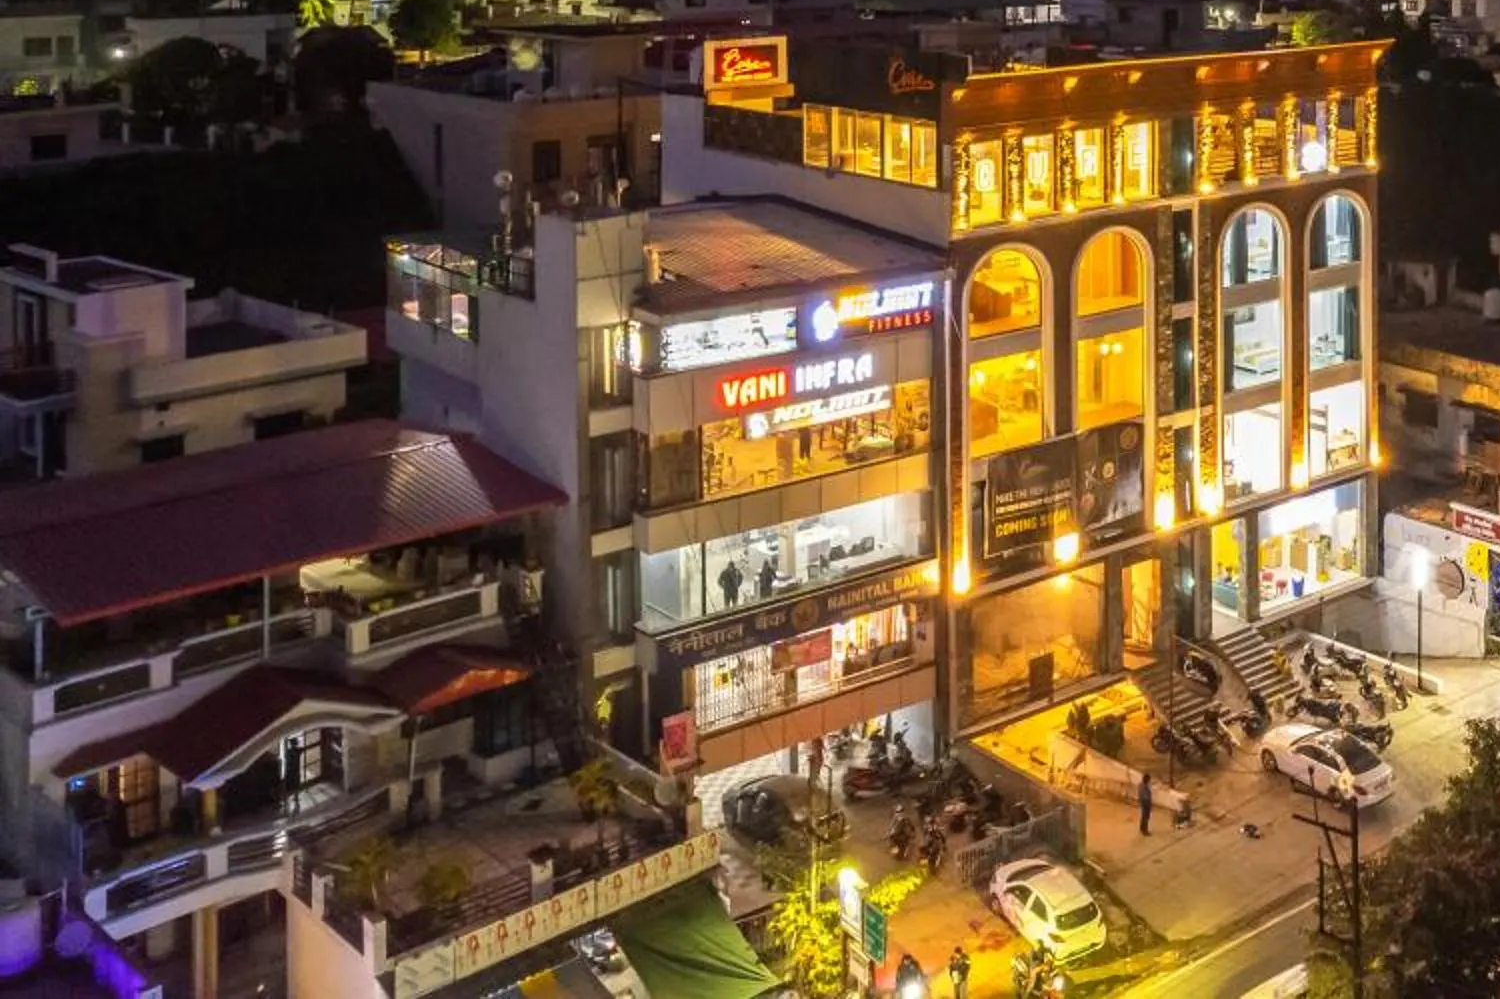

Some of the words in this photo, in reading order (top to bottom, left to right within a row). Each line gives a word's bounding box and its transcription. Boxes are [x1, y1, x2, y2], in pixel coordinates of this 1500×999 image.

[868, 311, 932, 333] FITNESS
[721, 373, 786, 407] VANI
[795, 353, 873, 393] INFRA
[827, 581, 892, 611] NAINITAL
